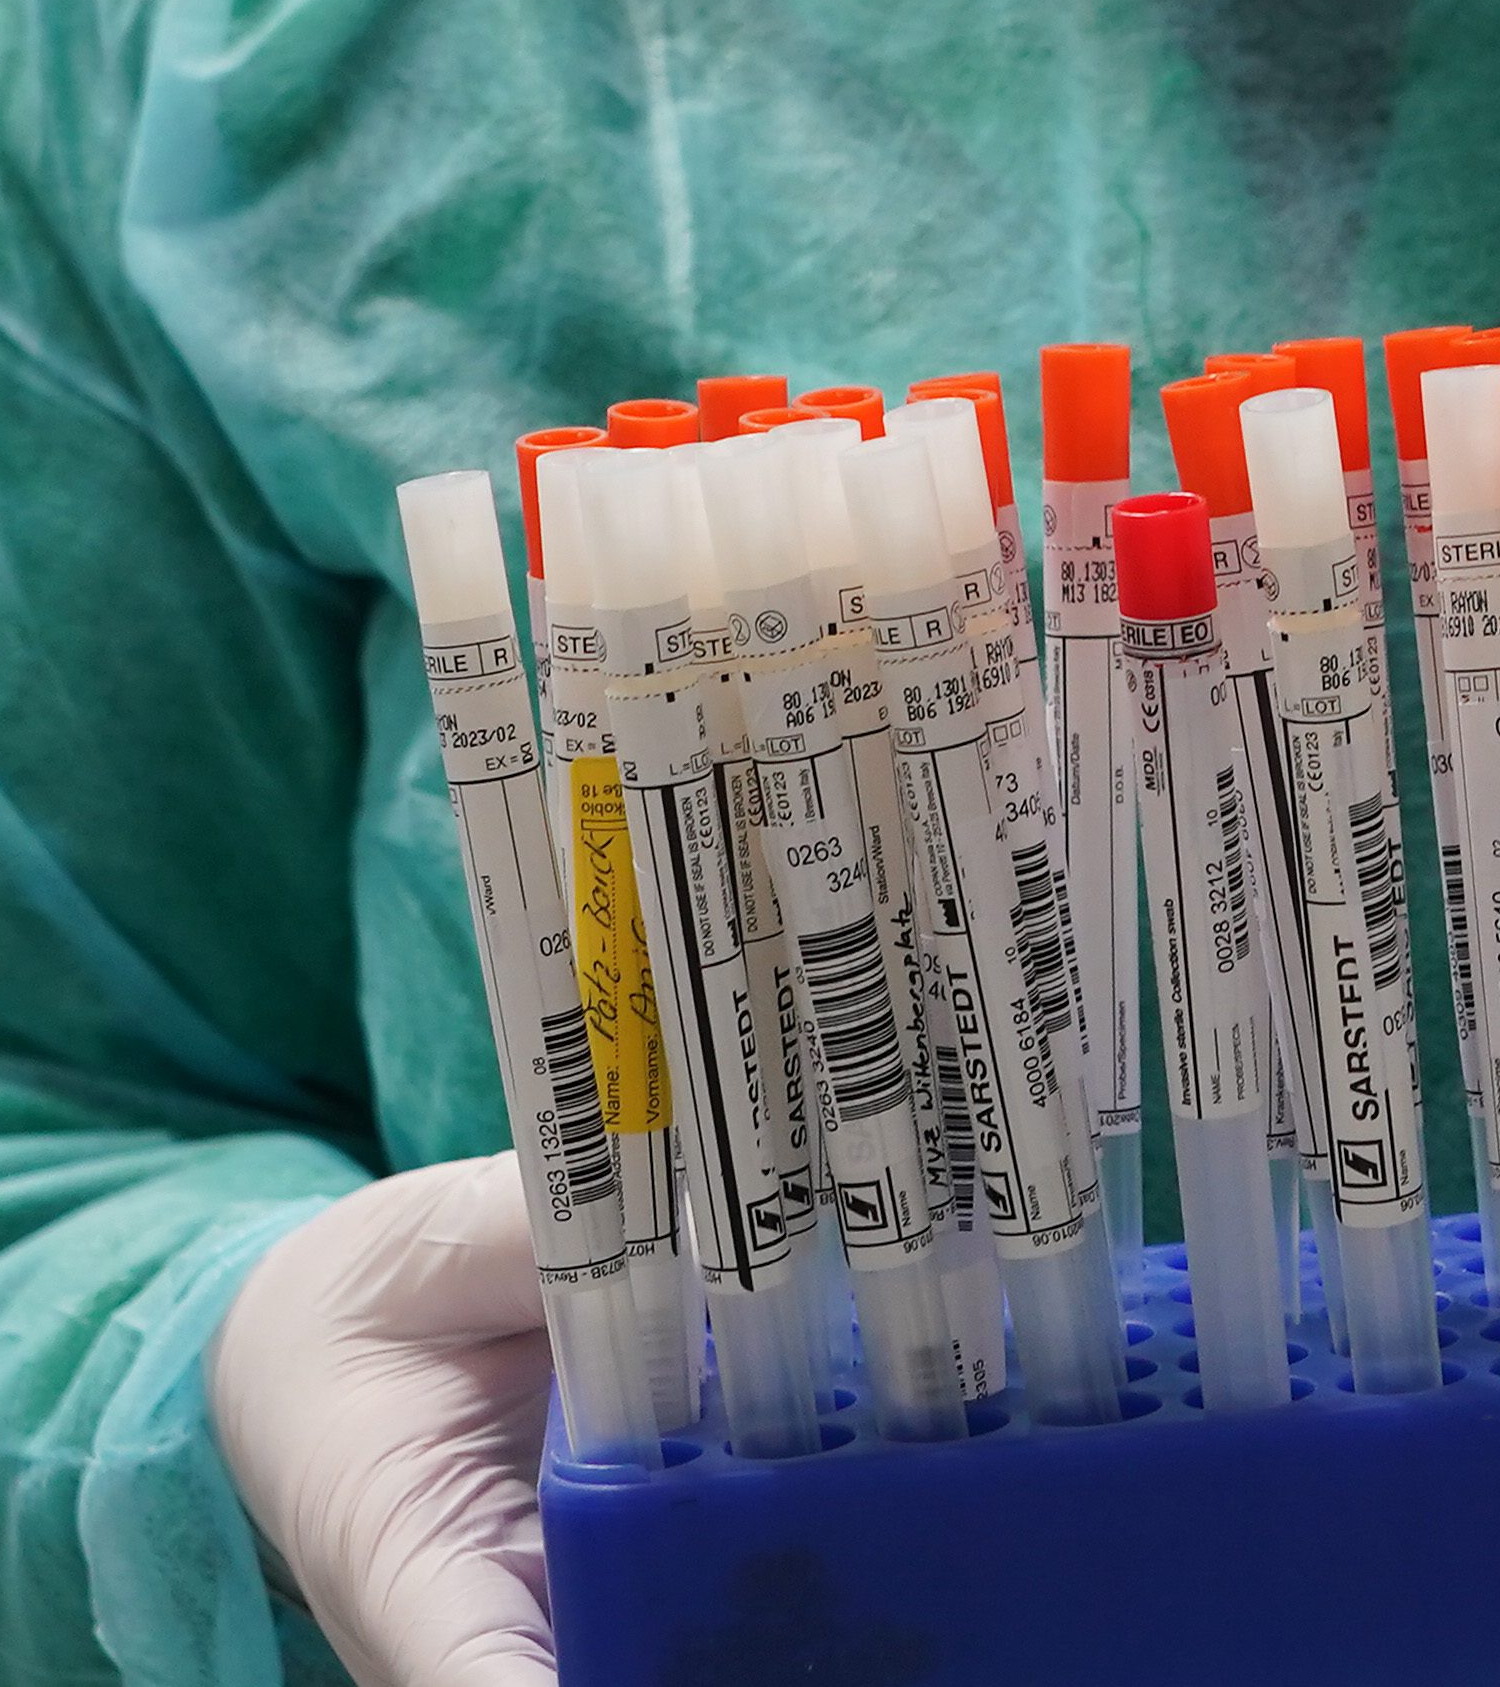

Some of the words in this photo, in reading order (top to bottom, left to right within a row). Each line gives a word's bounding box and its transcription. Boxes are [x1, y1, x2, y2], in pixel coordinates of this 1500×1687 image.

[1213, 551, 1228, 570] R
[964, 581, 980, 601] R
[925, 619, 942, 638] R
[1181, 624, 1208, 644] EO
[1304, 699, 1338, 714] LOT
[452, 723, 517, 749] 2023/02
[770, 737, 800, 753] LOT
[1142, 749, 1157, 792] MDD
[786, 836, 842, 868] 0263
[826, 857, 866, 893] 324
[1205, 860, 1227, 915] 3212
[1167, 937, 1182, 1003] Collection
[1212, 919, 1235, 973] 0028
[803, 1020, 825, 1072] 3240
[1010, 997, 1036, 1051] 6184
[774, 966, 807, 1149] SARSTEDT
[946, 963, 1002, 1154] SARSTEDT
[1023, 1055, 1047, 1108] 4000
[605, 1065, 621, 1126] Name:
[816, 1080, 839, 1133] 0263
[537, 1110, 562, 1161] 1326
[547, 1169, 572, 1222] 0263
